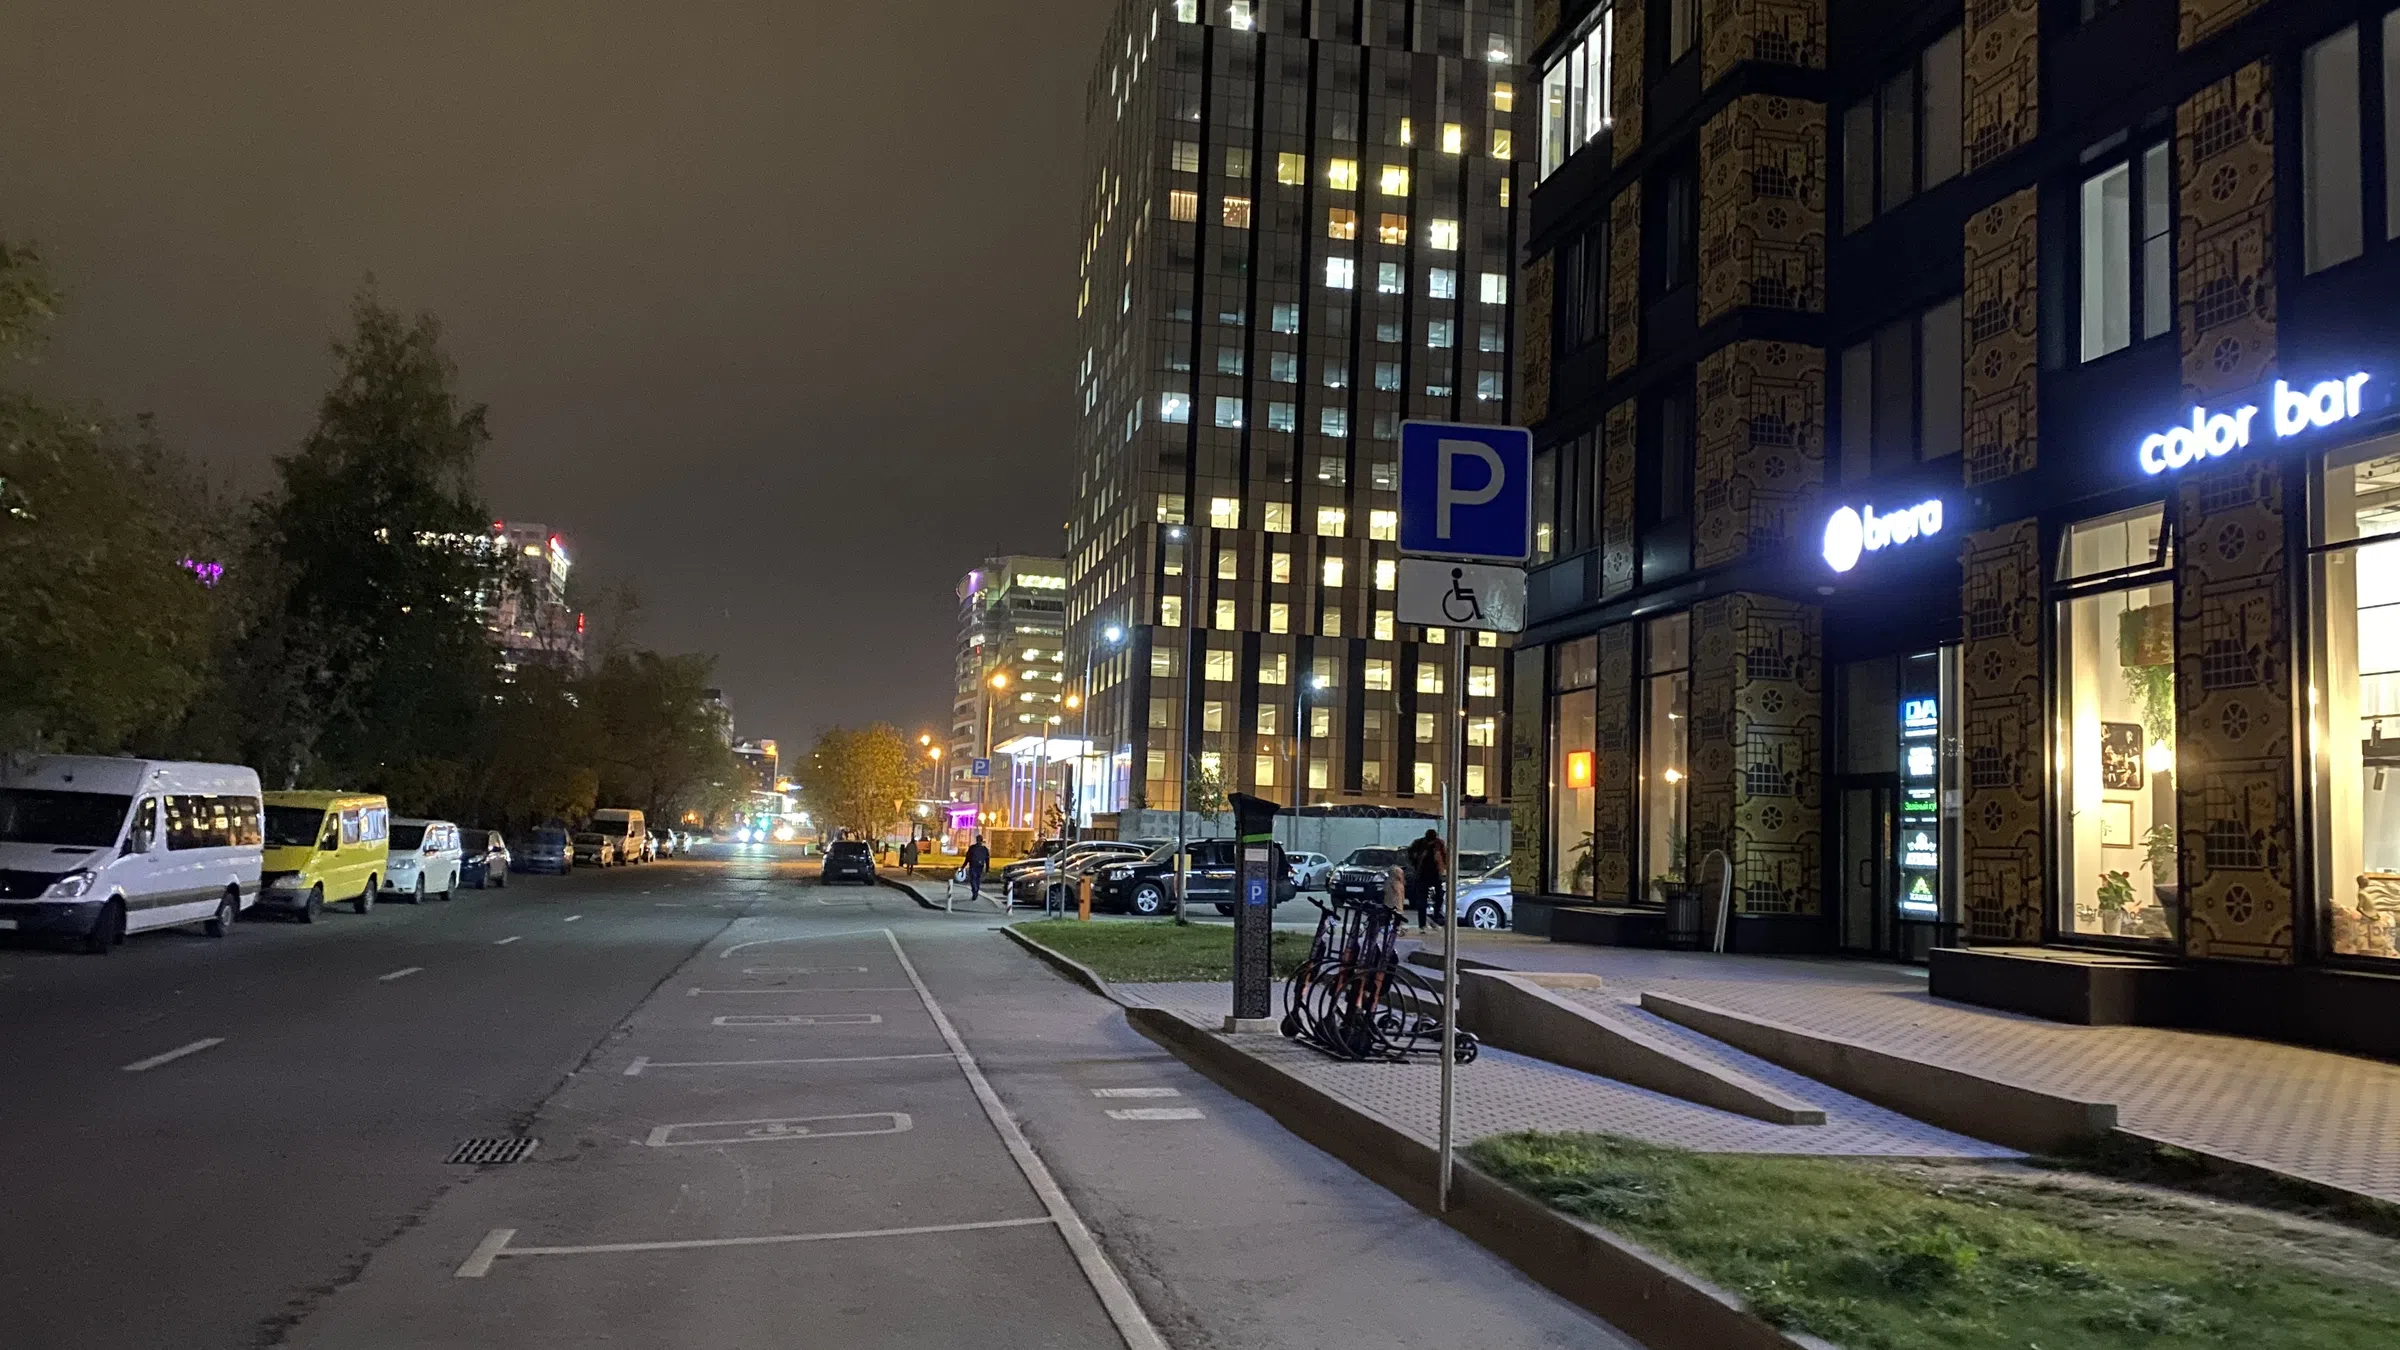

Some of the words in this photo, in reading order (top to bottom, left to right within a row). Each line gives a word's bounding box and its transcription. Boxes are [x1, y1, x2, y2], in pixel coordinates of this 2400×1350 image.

[2140, 405, 2258, 475] color
[2274, 372, 2370, 437] bar
[1436, 438, 1506, 539] P
[1863, 499, 1943, 551] brera
[974, 760, 986, 774] P
[1251, 885, 1262, 901] P
